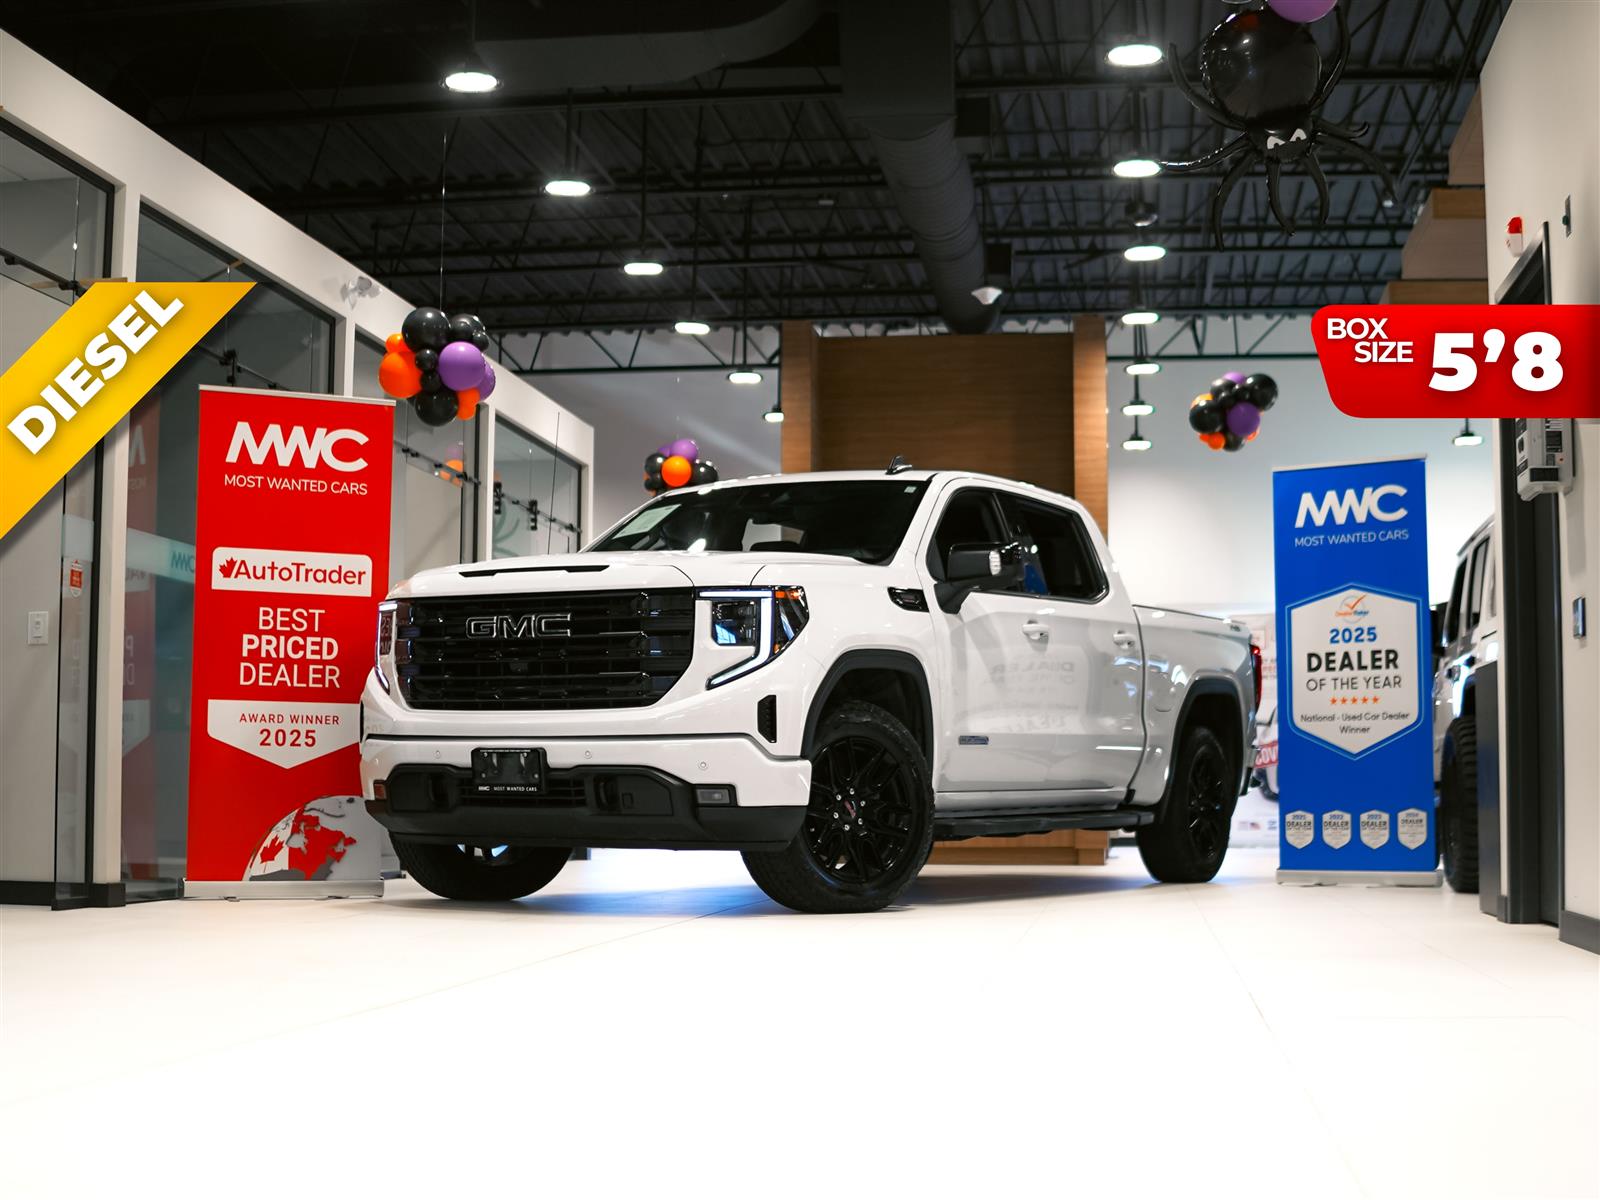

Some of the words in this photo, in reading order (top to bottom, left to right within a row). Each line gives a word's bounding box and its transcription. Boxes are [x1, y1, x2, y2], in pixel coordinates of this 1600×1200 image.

[225, 421, 369, 472] MWC
[224, 474, 264, 489] MOST
[267, 477, 328, 493] WANTED
[331, 481, 368, 496] CARS
[1295, 484, 1408, 528] MWC
[1295, 536, 1324, 547] MOST
[1328, 532, 1376, 545] WANTED
[1378, 529, 1409, 541] CARS
[234, 559, 366, 585] AutoTrader
[258, 607, 325, 632] BEST
[466, 613, 571, 638] GMC
[242, 634, 339, 660] PRICED
[1329, 627, 1378, 644] 2025
[1307, 649, 1399, 673] DEALER
[239, 662, 340, 688] DEALER
[1306, 678, 1326, 691] OF
[1331, 677, 1358, 690] THE
[1363, 675, 1402, 689] YEAR
[239, 713, 285, 724] AWARD
[290, 714, 340, 725] WINNER
[1301, 714, 1335, 722] National
[1341, 713, 1362, 721] Used
[1364, 712, 1379, 721] Car
[1382, 711, 1410, 720] Dealer
[259, 729, 317, 747] 2025
[1339, 725, 1370, 734] Winner
